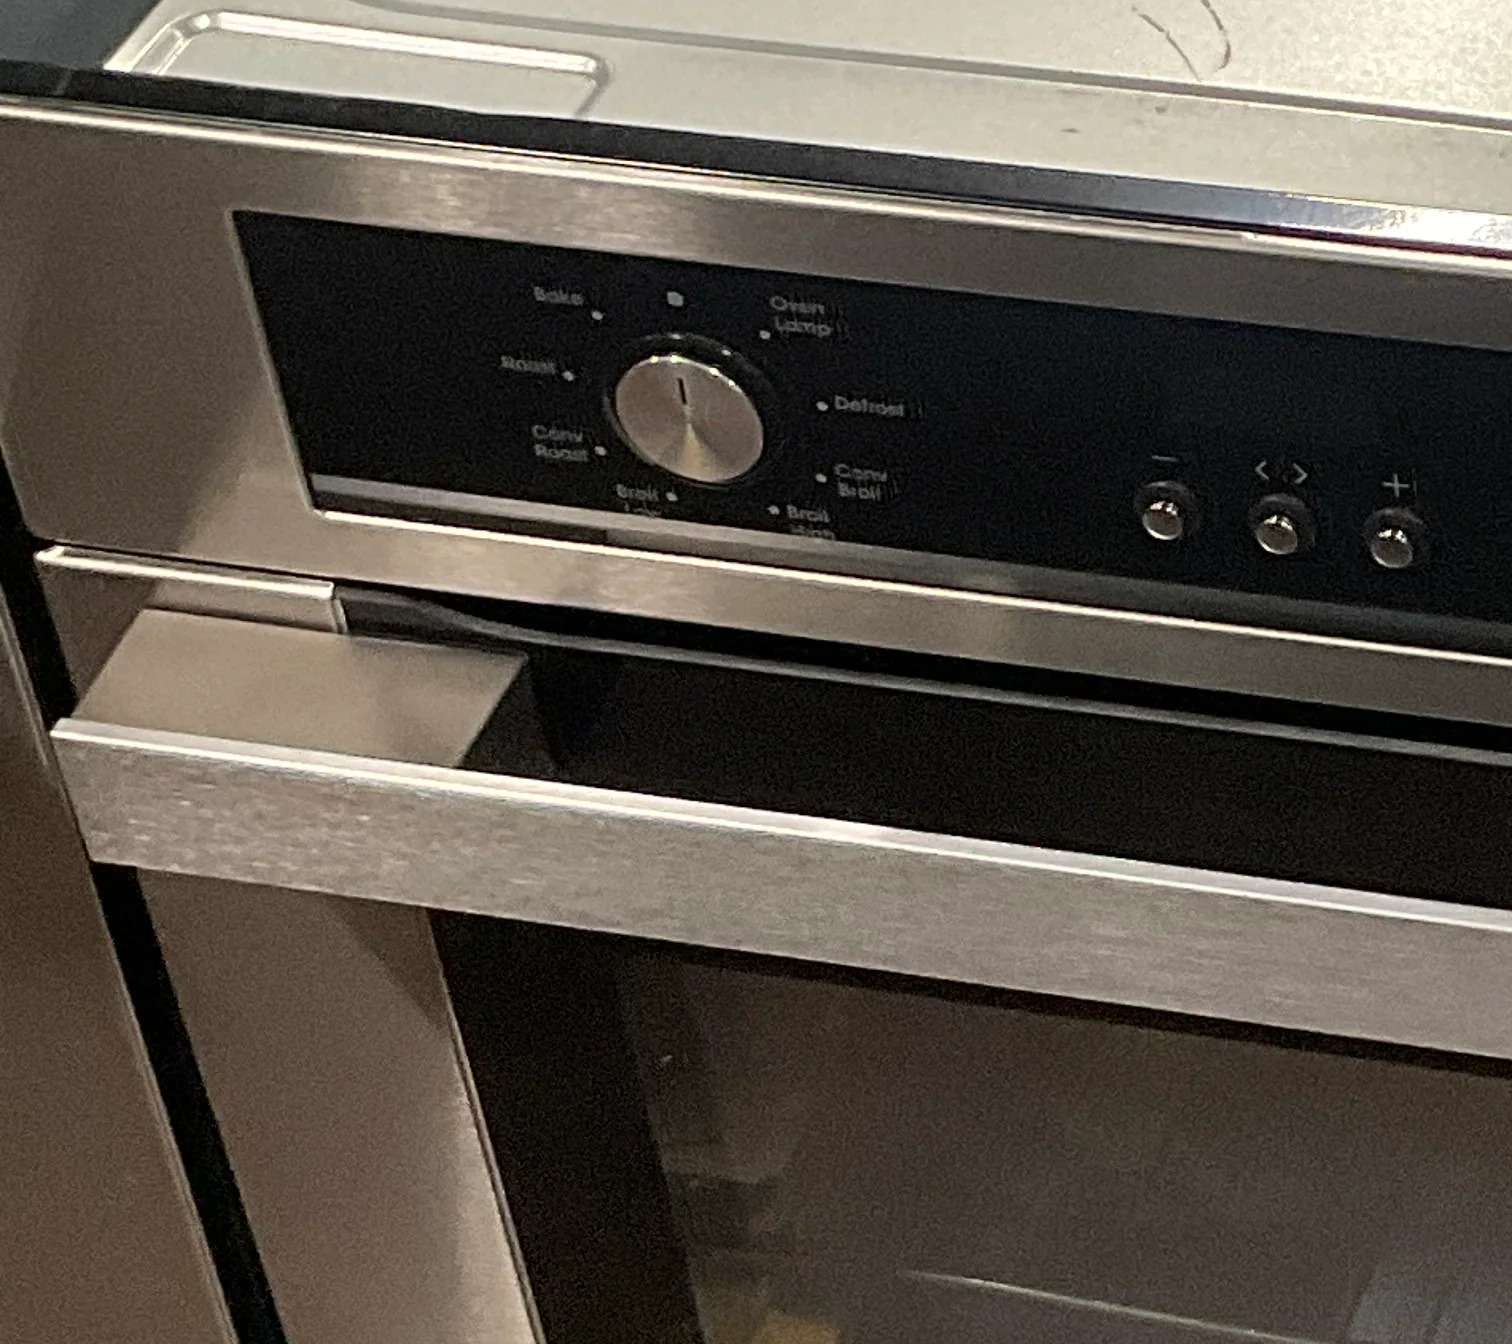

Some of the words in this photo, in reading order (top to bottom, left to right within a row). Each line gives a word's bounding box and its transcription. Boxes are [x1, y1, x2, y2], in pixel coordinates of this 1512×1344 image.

[533, 286, 585, 306] Bake
[769, 295, 826, 315] Oven
[774, 315, 833, 338] Lamp
[501, 355, 557, 374] Roast
[834, 394, 905, 417] Defrost
[531, 424, 583, 442] Conv
[534, 443, 589, 462] Roast
[834, 463, 888, 483] Conv
[838, 481, 882, 501] Broil
[786, 504, 831, 523] Broil
